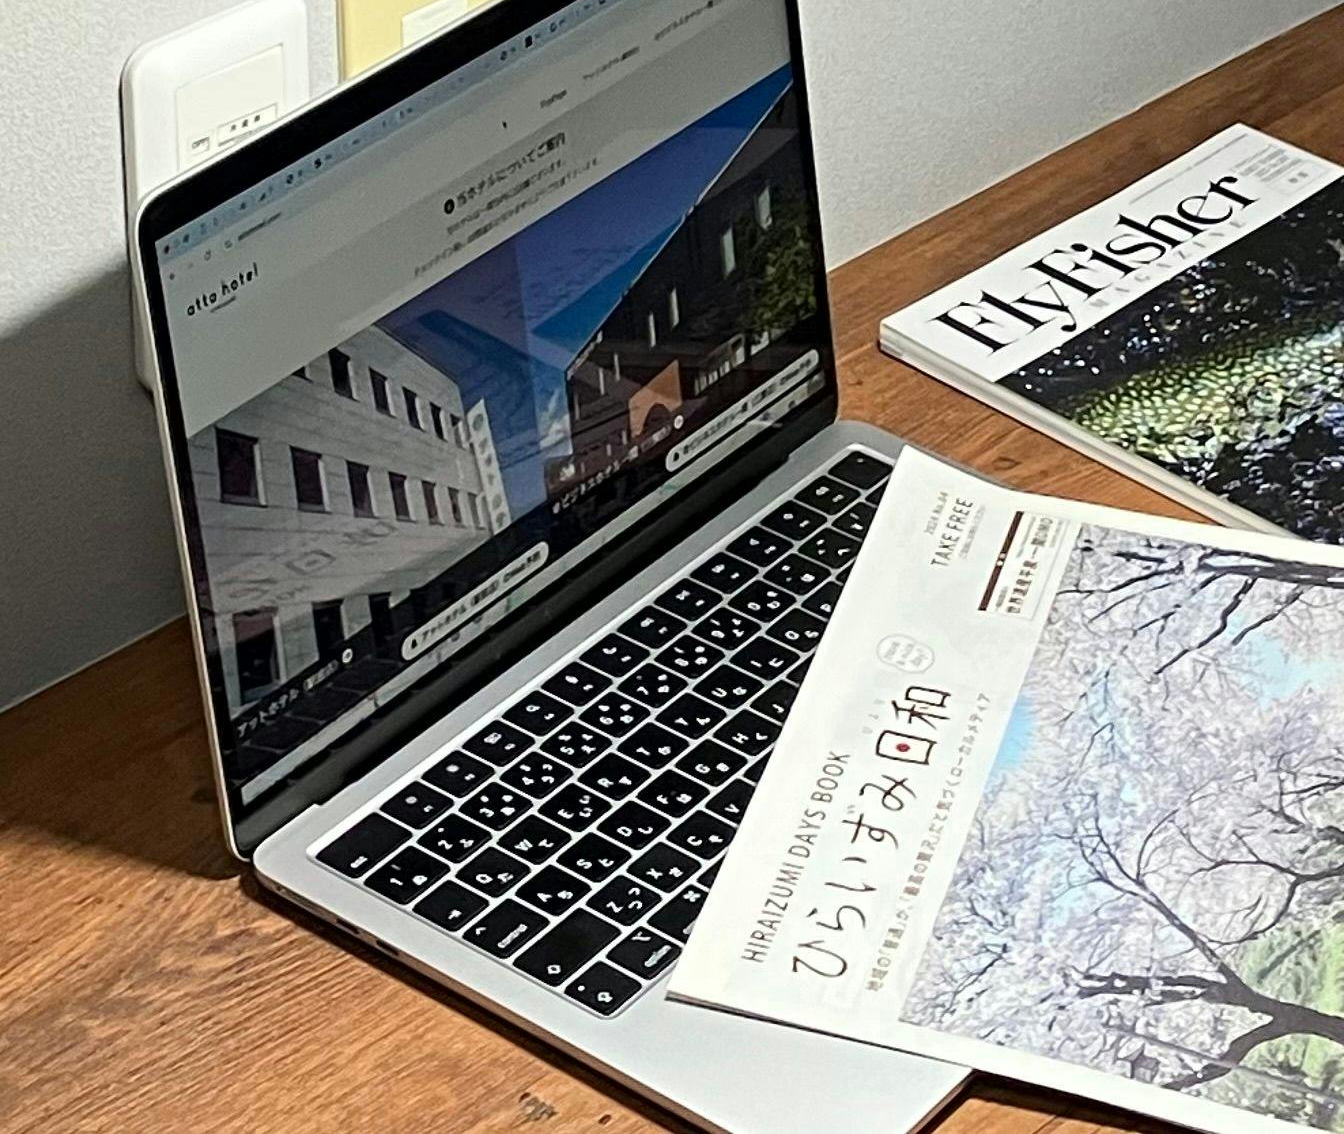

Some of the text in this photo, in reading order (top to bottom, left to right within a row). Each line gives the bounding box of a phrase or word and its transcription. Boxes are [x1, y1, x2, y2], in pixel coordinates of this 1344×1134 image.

[929, 174, 1261, 355] FlyFisher
[930, 532, 960, 567] TAKE
[946, 497, 974, 534] FREE
[742, 750, 851, 964] HIRAIZUMI DAYS BOOK
[791, 686, 952, 979] ひらいずみ日和
